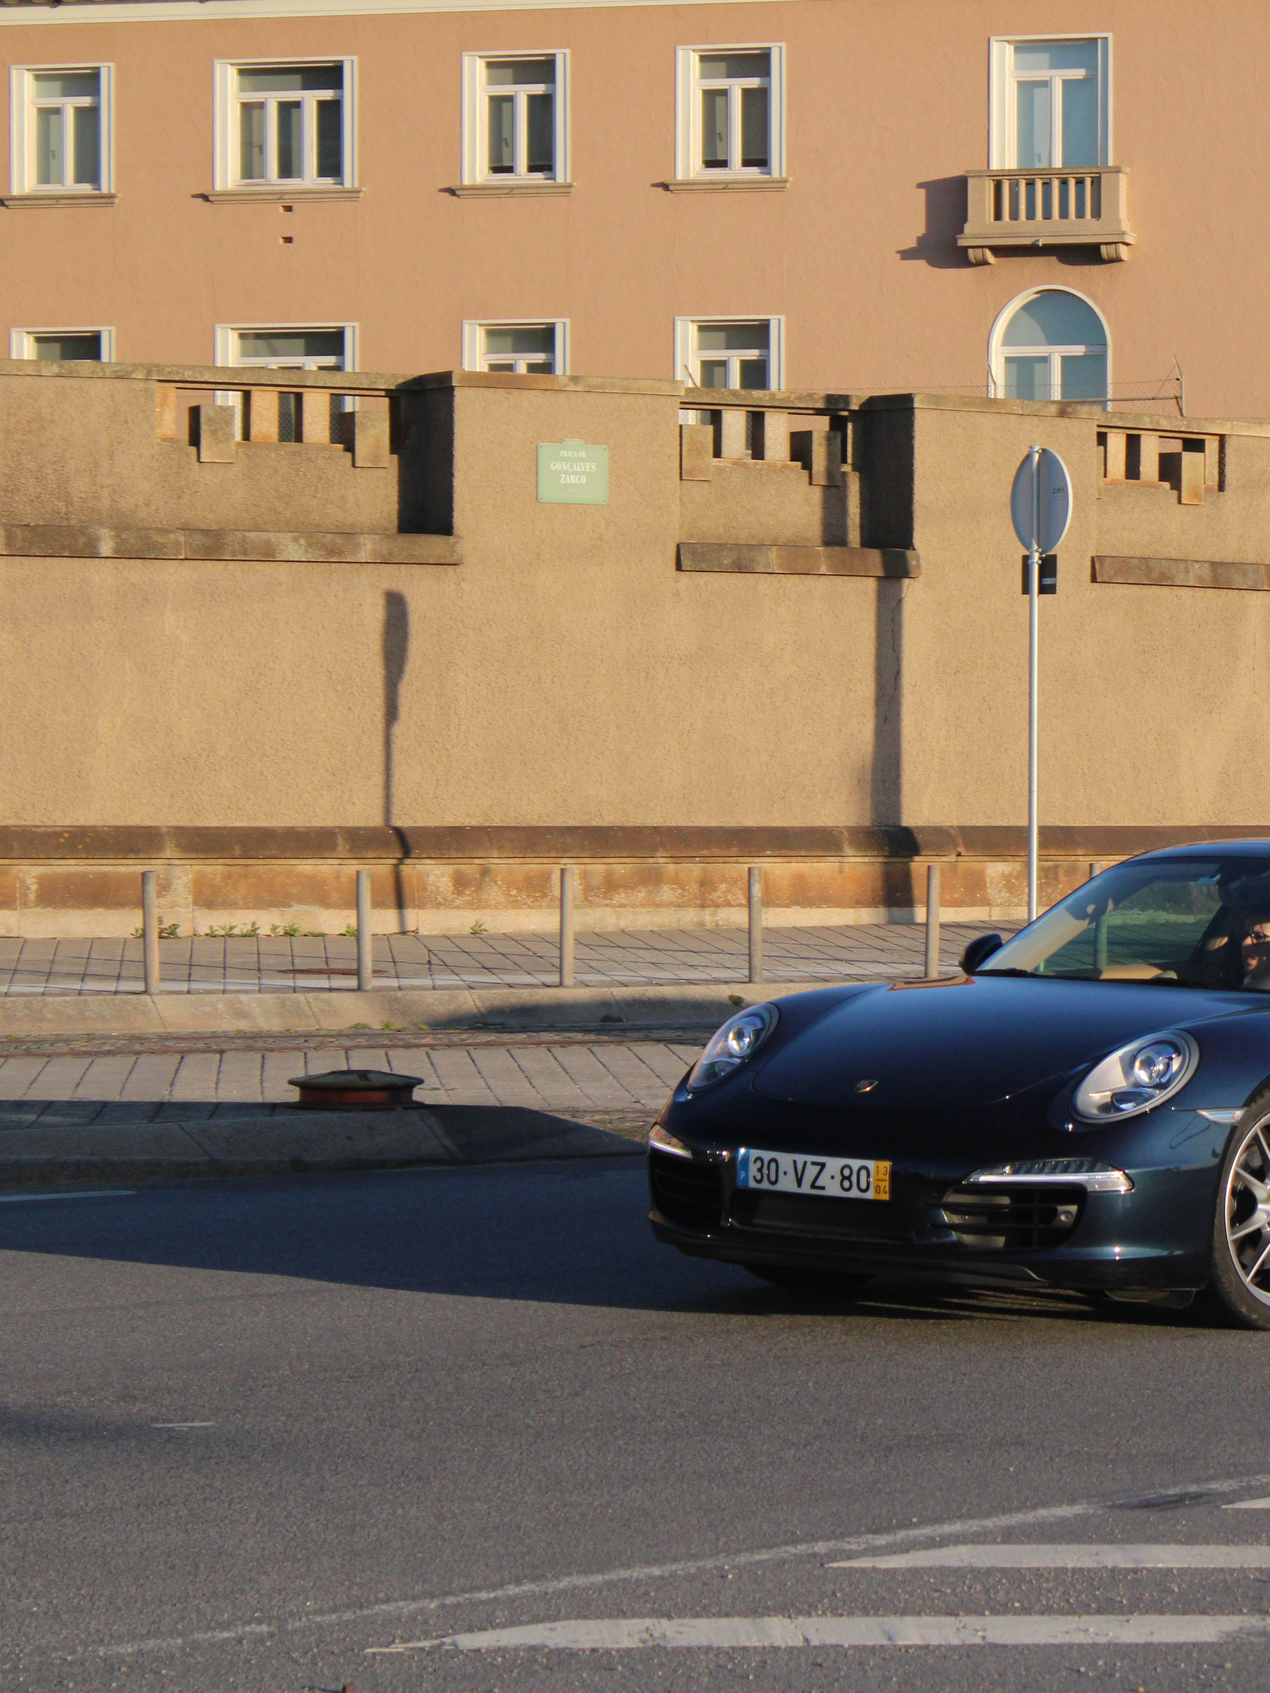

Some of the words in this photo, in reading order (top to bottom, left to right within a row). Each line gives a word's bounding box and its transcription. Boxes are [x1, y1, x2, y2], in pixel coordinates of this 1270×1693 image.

[560, 450, 577, 458] PRAÇA
[550, 461, 596, 473] GONÇALVES
[560, 474, 586, 484] ZARCO
[740, 1171, 746, 1180] P
[875, 1165, 888, 1176] 13
[875, 1184, 888, 1195] 04
